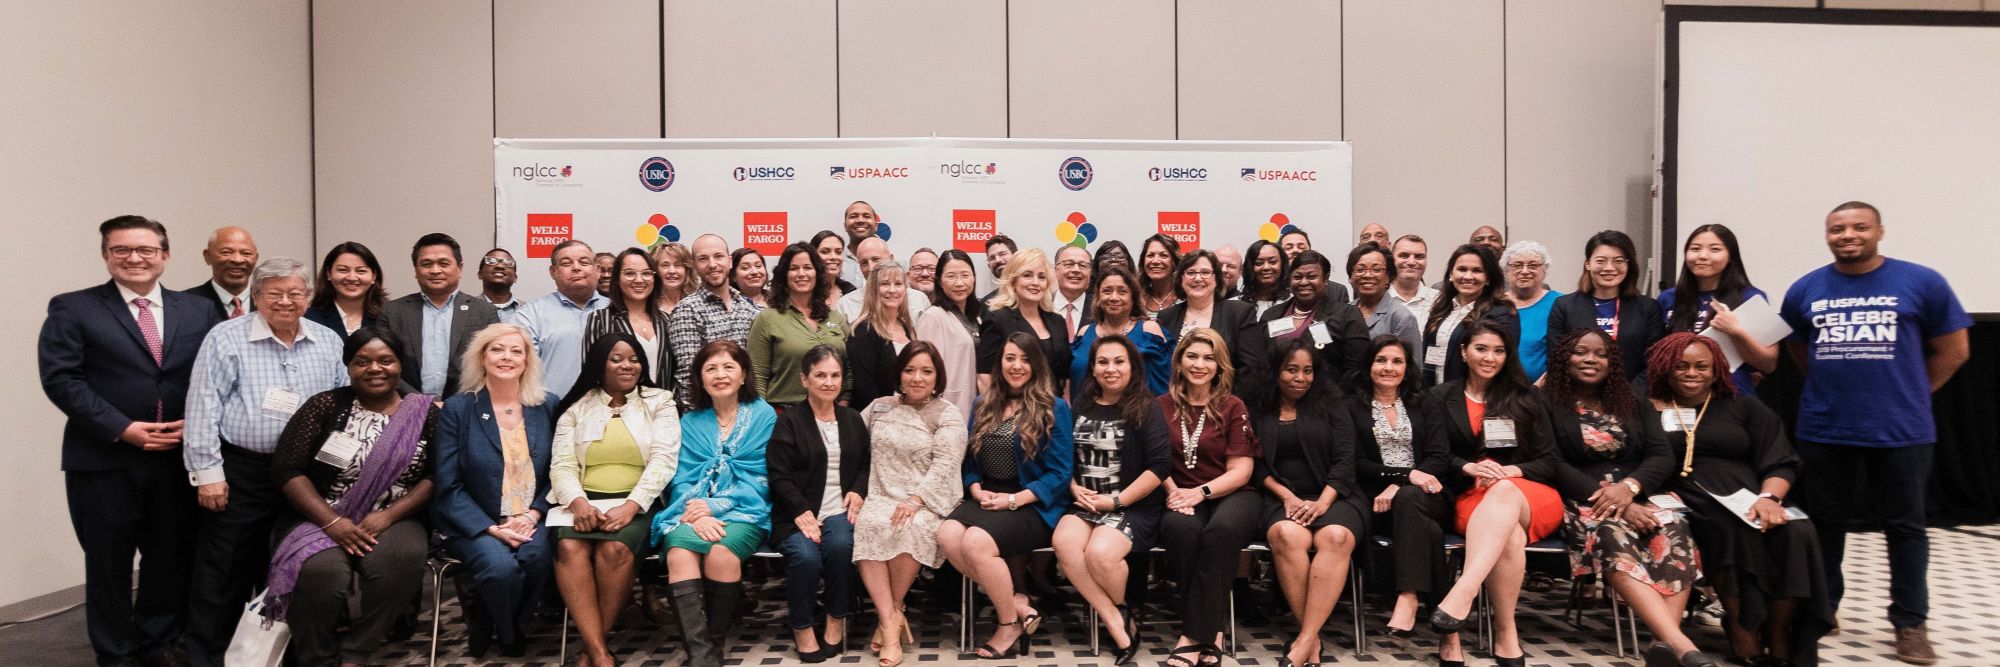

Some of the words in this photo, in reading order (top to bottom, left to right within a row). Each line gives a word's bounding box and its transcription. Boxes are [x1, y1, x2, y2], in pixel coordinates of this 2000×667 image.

[513, 163, 557, 181] nglcc
[748, 167, 795, 178] USHCC
[848, 168, 908, 178] USPAACC
[941, 160, 982, 178] nglcc
[1163, 168, 1207, 178] USHCC
[645, 169, 670, 180] USBC
[1259, 170, 1317, 181] USPAACC
[530, 226, 569, 235] WELLS
[747, 224, 784, 233] WELLS
[956, 221, 993, 230] WELLS
[1160, 223, 1197, 232] WELLS
[748, 235, 785, 244] FARGO
[957, 232, 993, 241] FARGO
[1169, 234, 1197, 243] RGO
[1829, 296, 1899, 308] USPAACC
[1812, 310, 1898, 328] CELEBR
[1815, 325, 1897, 344] ASIAN
